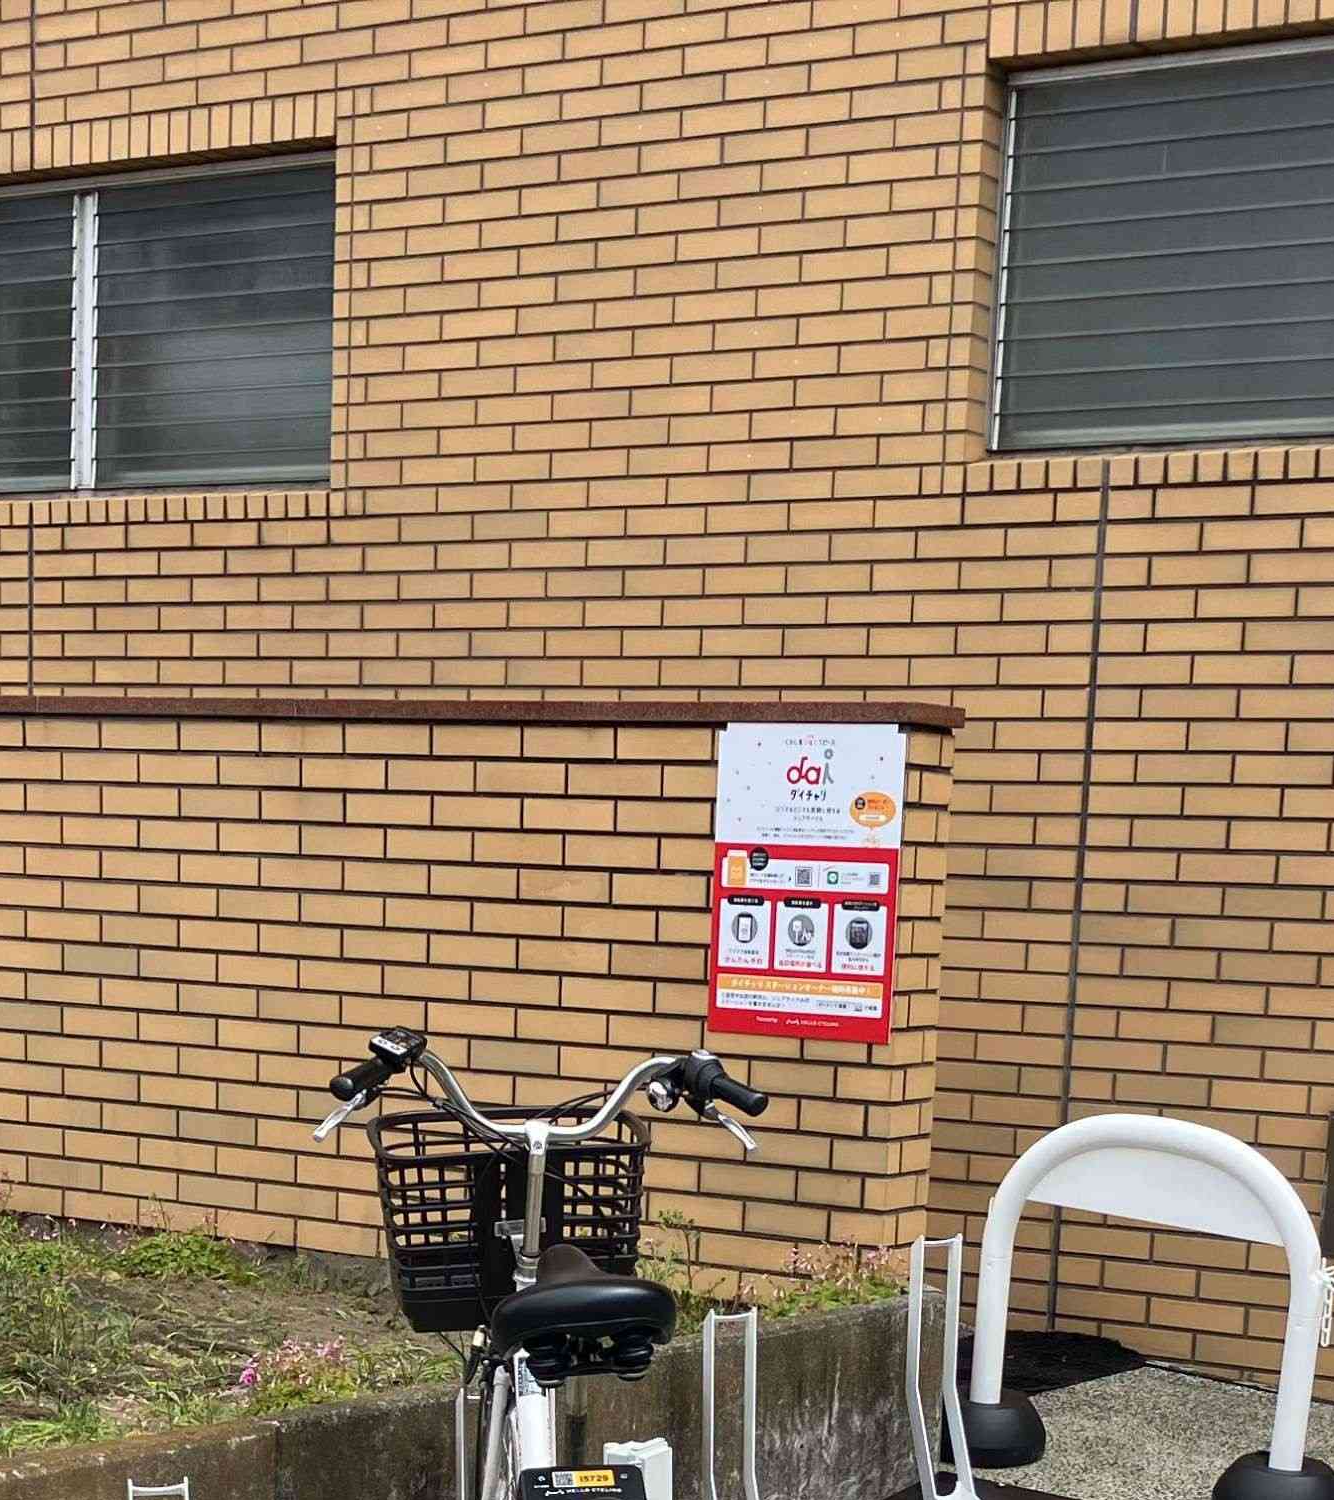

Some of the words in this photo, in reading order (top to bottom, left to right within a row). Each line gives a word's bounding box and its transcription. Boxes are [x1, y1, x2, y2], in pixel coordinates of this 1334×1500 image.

[790, 789, 827, 801] ダイチャリ
